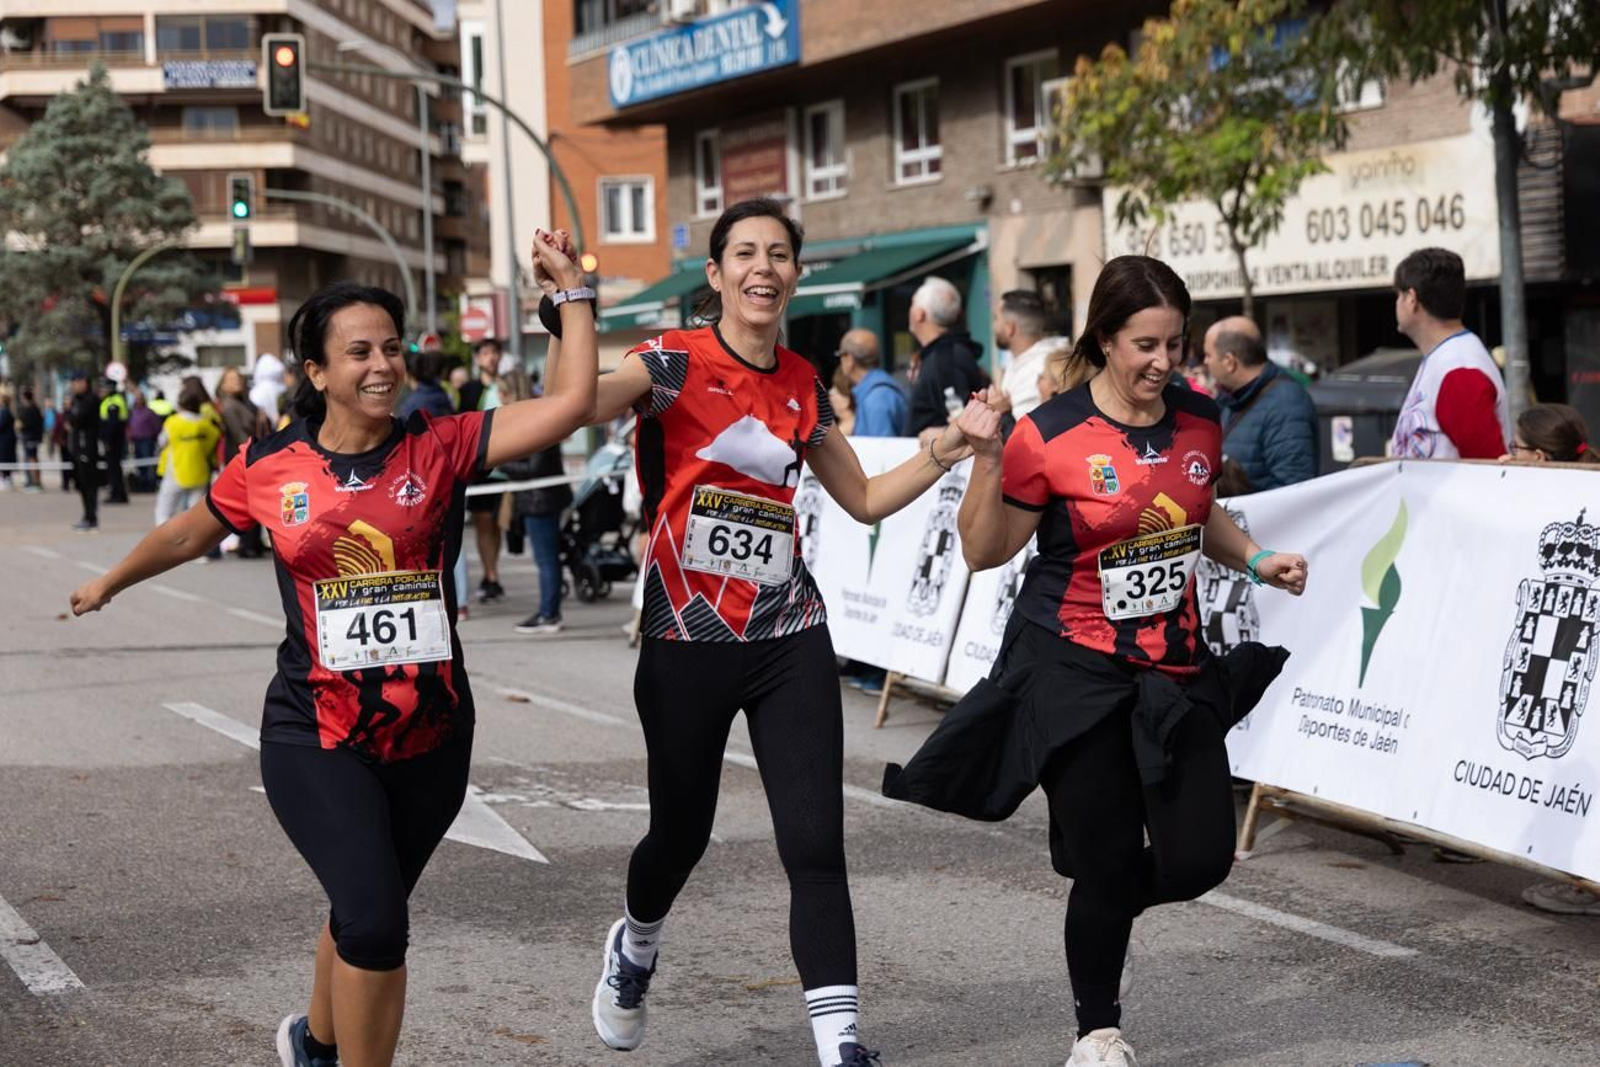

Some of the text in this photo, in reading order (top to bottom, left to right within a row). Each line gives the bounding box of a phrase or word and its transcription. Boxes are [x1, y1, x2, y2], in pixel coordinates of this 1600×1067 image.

[1306, 193, 1466, 244] 603 045 046
[1168, 222, 1206, 257] 650
[697, 491, 723, 509] XXV
[723, 496, 761, 509] CARRERA
[732, 504, 755, 514] gran
[708, 524, 773, 565] 634
[1139, 545, 1161, 556] gran
[1164, 535, 1198, 549] caminata
[319, 581, 348, 600] XXV
[349, 577, 394, 589] CARRERA
[362, 585, 387, 596] gran
[392, 581, 437, 592] caminata
[1126, 560, 1186, 600] 325
[346, 607, 417, 645] 461
[1291, 687, 1345, 714] Patronato
[1348, 698, 1403, 730] Municipal
[1298, 714, 1399, 754] Deportes de Jaén
[1454, 760, 1593, 818] CIUDAD DE JAÉN
